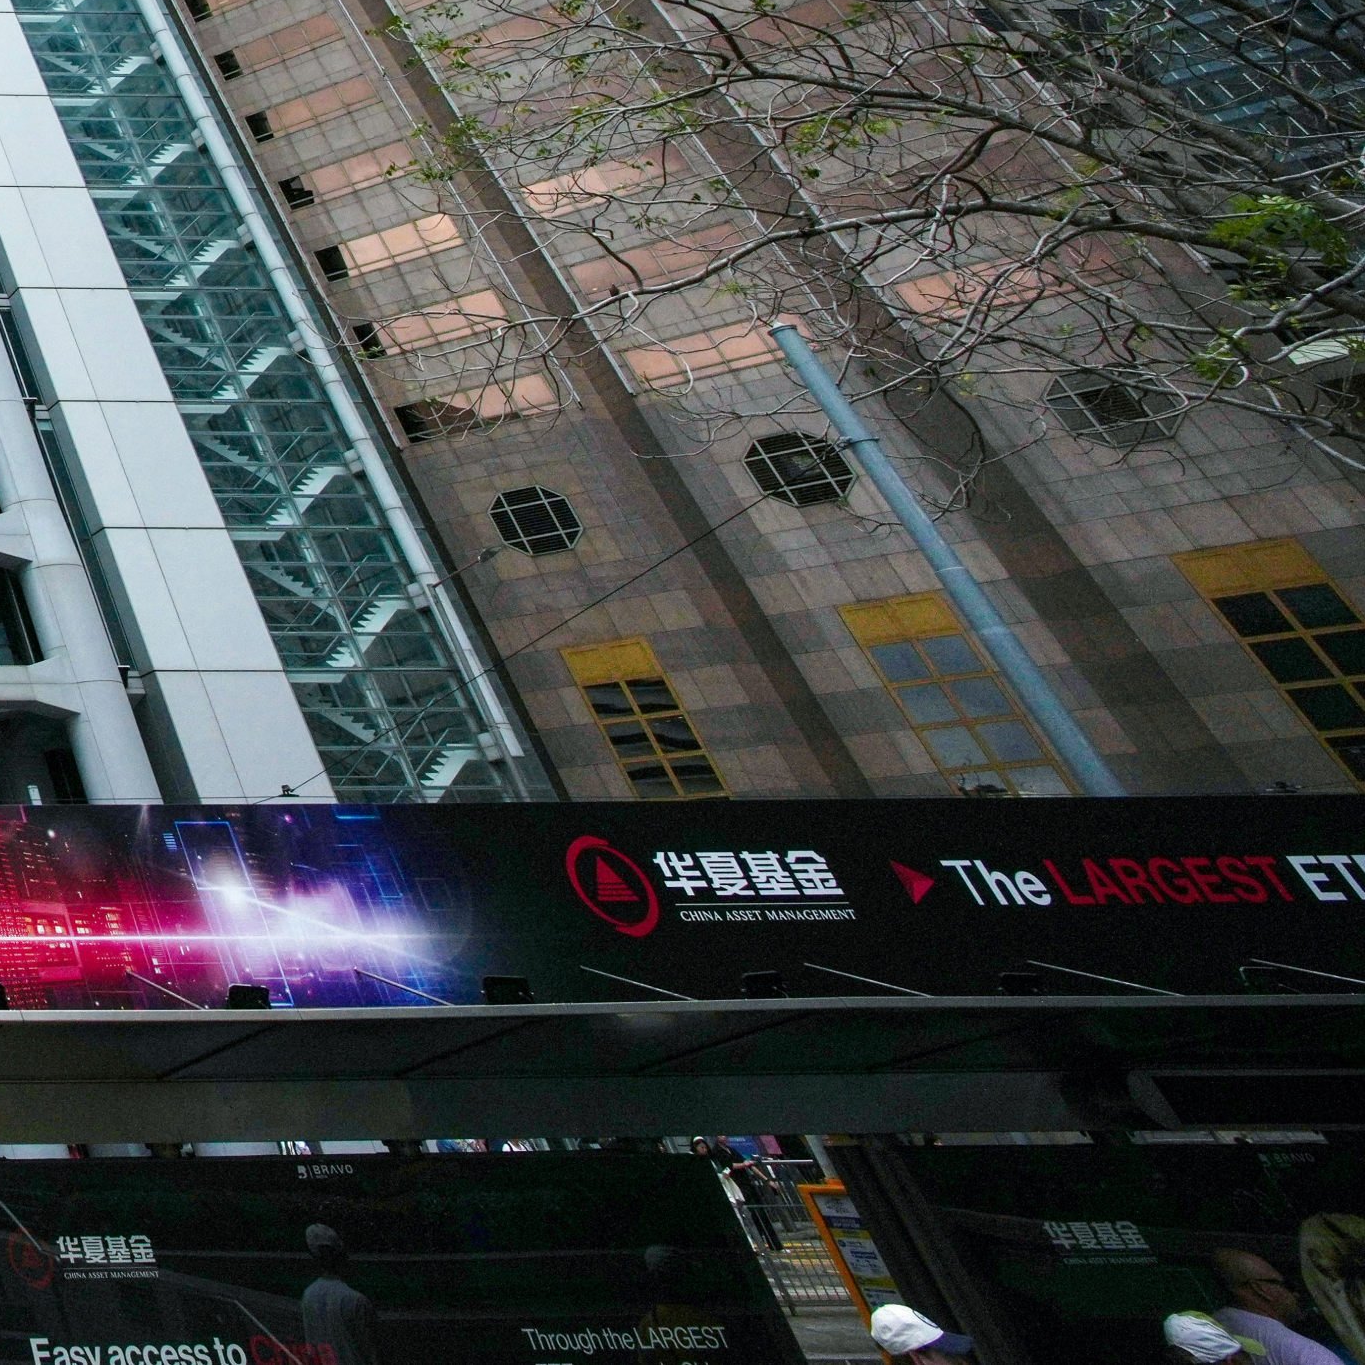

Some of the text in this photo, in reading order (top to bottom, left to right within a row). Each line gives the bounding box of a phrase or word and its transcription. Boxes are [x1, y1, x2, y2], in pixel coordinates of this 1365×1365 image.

[652, 850, 846, 896] 华夏基金
[939, 859, 1052, 906] The
[1042, 855, 1296, 906] LARGEST
[679, 908, 858, 922] CHINA ASSET MANAGEMENT
[312, 1164, 354, 1175] BRAVO
[56, 1234, 157, 1264] 华夏基金
[1042, 1220, 1150, 1250] 华夏基金
[63, 1270, 159, 1280] CHINA ASSET MANAGEMENT
[29, 1337, 101, 1365] Easy
[107, 1342, 212, 1365] access
[213, 1336, 248, 1365] to
[521, 1326, 729, 1356] Through the LARGEST
